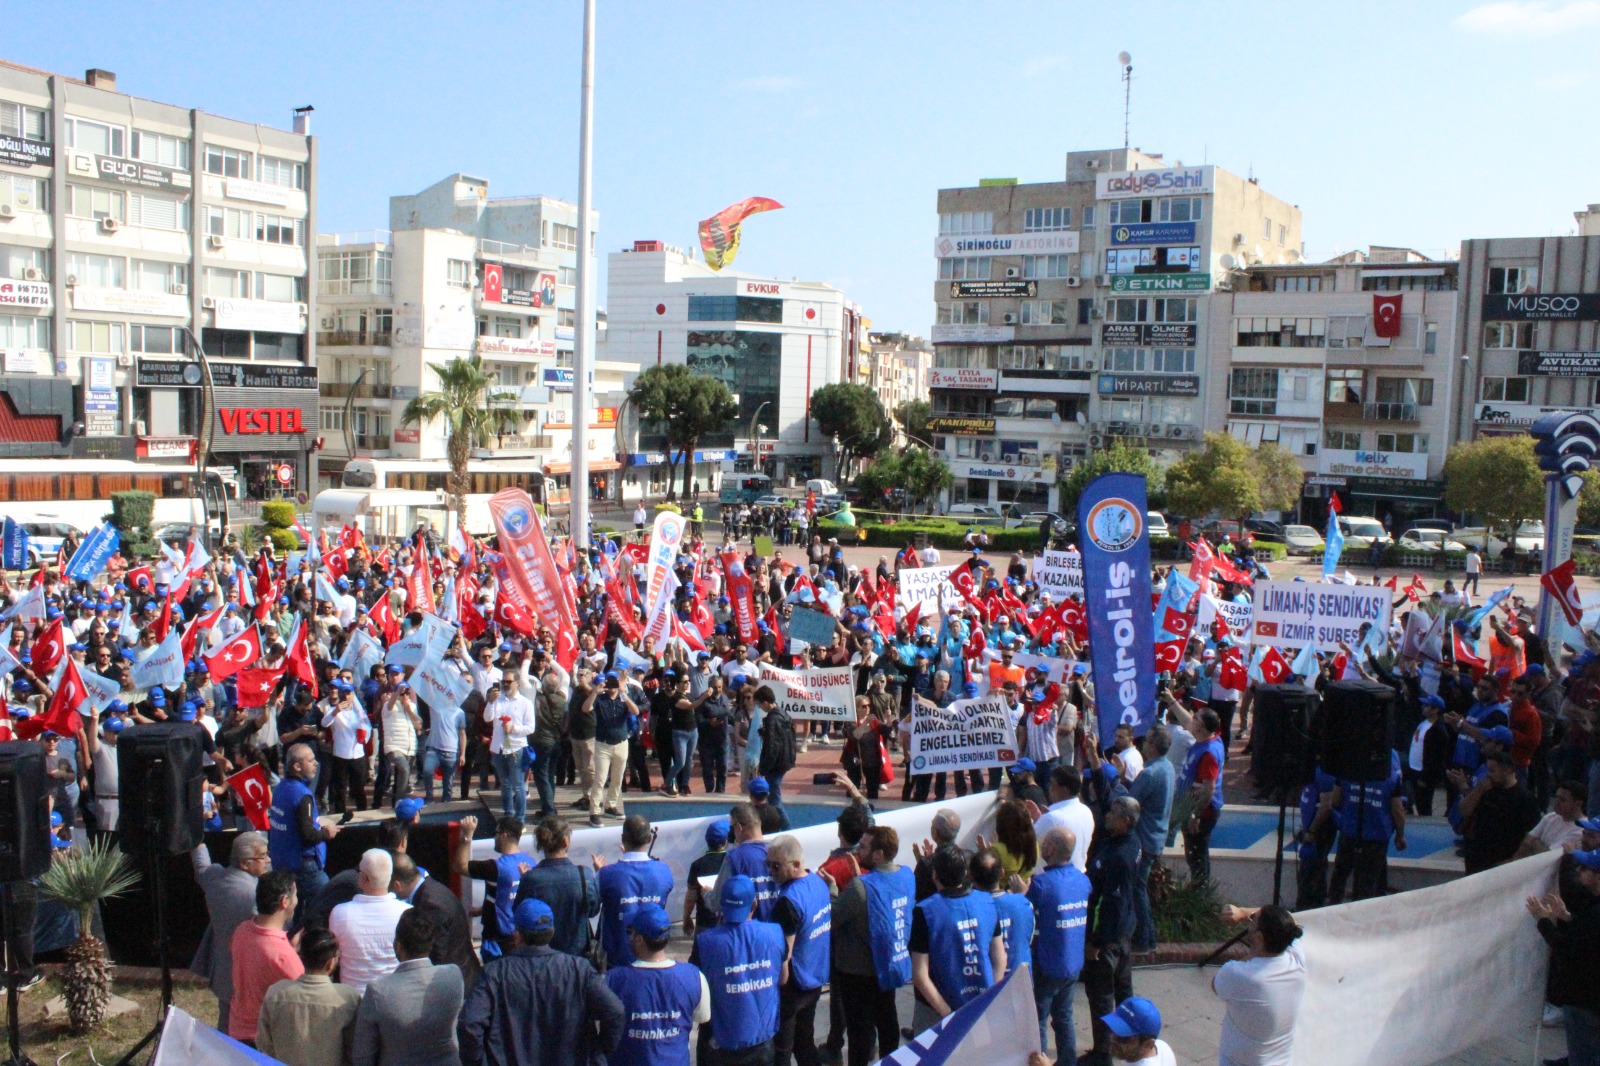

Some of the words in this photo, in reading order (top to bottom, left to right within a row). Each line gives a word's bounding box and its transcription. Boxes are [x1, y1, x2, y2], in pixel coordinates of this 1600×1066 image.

[22, 141, 51, 157] İNŞAAT
[957, 238, 1012, 253] ŞİRİNOĞLU
[747, 282, 780, 294] EVKUR
[1130, 275, 1184, 289] ETKİN
[1108, 325, 1136, 333] ARAS
[1152, 325, 1189, 333] ÖLMEZ
[142, 363, 180, 371] ARABULUCU
[1541, 358, 1600, 366] AVUKAT
[265, 367, 299, 375] AVUKAT
[245, 375, 279, 386] Hamit
[280, 375, 319, 388] ERDEM
[1114, 379, 1127, 391] İYİ
[1130, 379, 1164, 391] PARTİ
[220, 407, 307, 434] VESTEL
[151, 440, 188, 451] ECZANE
[1356, 451, 1389, 464] Helix
[1218, 602, 1252, 617] YAŞASI
[1263, 585, 1316, 621] LİMAN-İŞ
[1281, 620, 1315, 642] İZMİR
[1318, 626, 1359, 646] ŞUBES
[1105, 560, 1142, 729] petrol-iş
[810, 672, 851, 689] DÜŞÜNCE
[787, 687, 823, 702] DERNEĞİ
[809, 704, 848, 716] ŞUBESİ
[964, 702, 1003, 717] OLMAK
[913, 719, 966, 735] ANAYASAL
[920, 731, 1006, 752] ENGELLENEMEZ
[928, 750, 957, 767] LİMAN-İŞ
[959, 750, 997, 764] SENDİKASI
[892, 896, 908, 910] SEN
[957, 918, 979, 931] SEN
[964, 943, 980, 954] KA
[724, 958, 773, 976] petrol-iş
[962, 965, 982, 976] OL
[725, 976, 775, 995] SENDİKASI
[631, 1011, 681, 1024] petrol-iş
